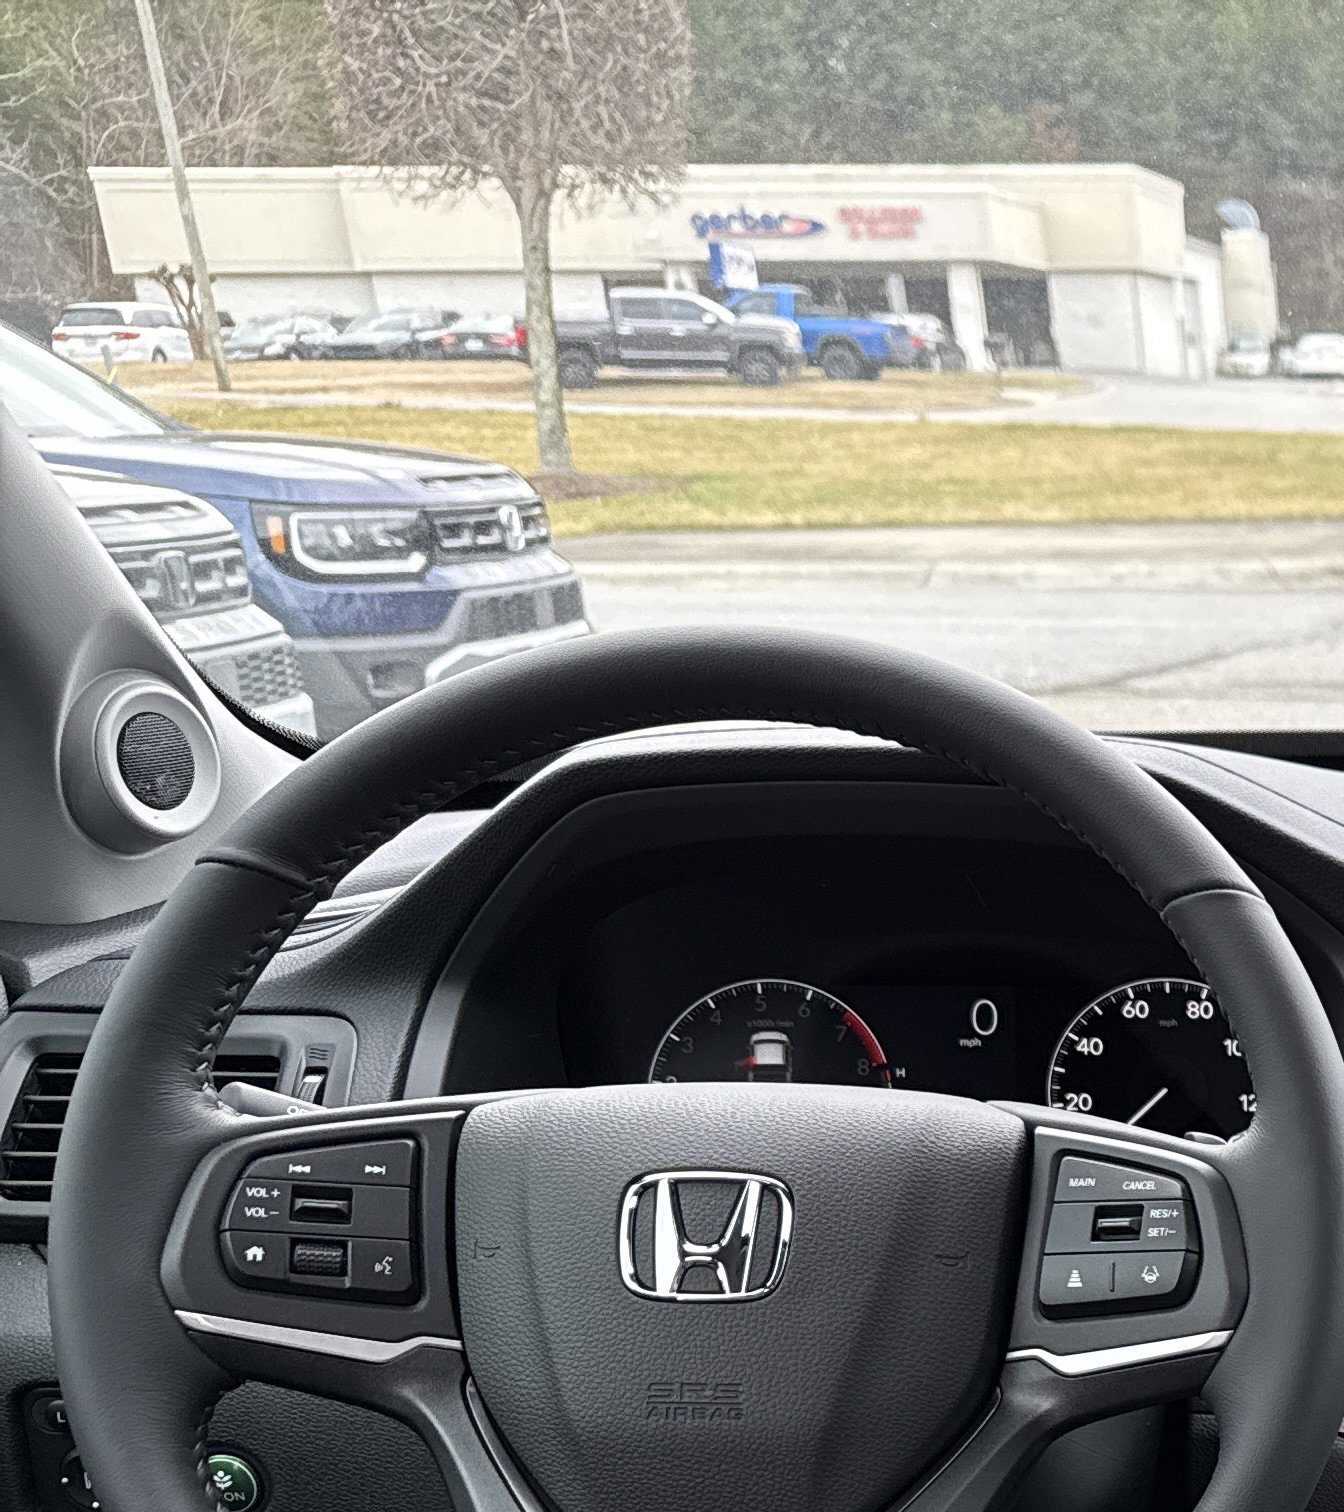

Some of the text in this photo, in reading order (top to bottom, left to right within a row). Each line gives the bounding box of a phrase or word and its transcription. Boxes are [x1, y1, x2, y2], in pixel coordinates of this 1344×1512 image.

[756, 996, 767, 1012] 5
[799, 1003, 811, 1018] 6
[1121, 999, 1150, 1019] 60
[1186, 1000, 1214, 1020] 80
[710, 1010, 722, 1026] 4
[971, 999, 998, 1036] 0
[835, 1026, 847, 1043] 7
[681, 1038, 694, 1054] 3
[959, 1038, 982, 1048] mph
[1075, 1037, 1103, 1056] 40
[857, 1059, 869, 1076] 8
[1065, 1092, 1093, 1111] 20
[1069, 1177, 1096, 1188] MAIN
[1122, 1180, 1157, 1191] CANCEL
[246, 1186, 270, 1198] VOL
[244, 1206, 269, 1218] VOL
[223, 1491, 246, 1502] ON
